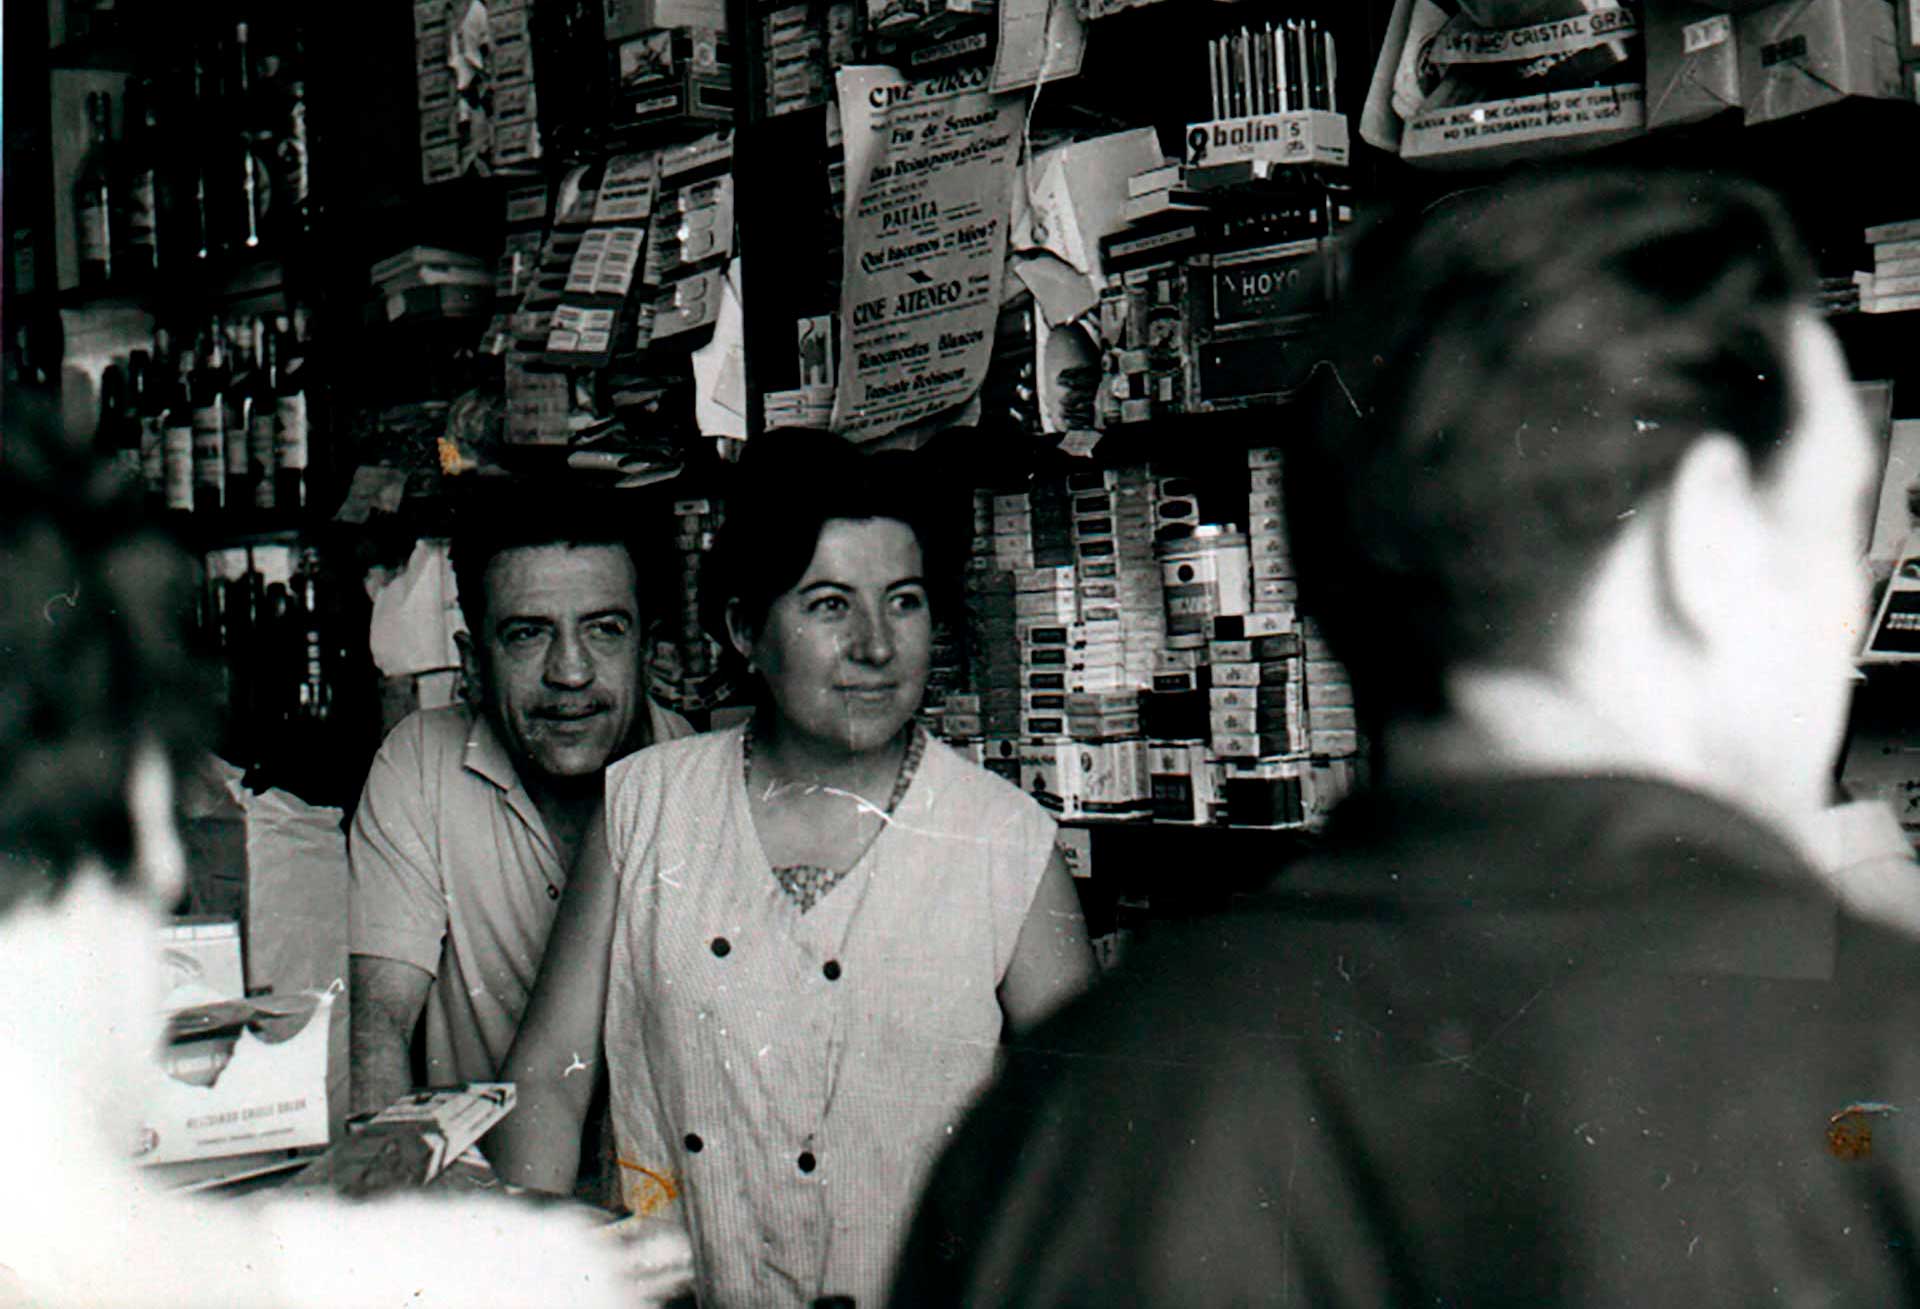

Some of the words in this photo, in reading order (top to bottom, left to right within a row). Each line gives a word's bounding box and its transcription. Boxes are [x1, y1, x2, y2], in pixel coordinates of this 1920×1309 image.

[1511, 18, 1584, 48] CRISTAL
[868, 81, 914, 108] CINE
[925, 65, 989, 96] CIRCO
[891, 127, 915, 145] Fin
[921, 121, 939, 139] de
[943, 109, 999, 132] Semana
[881, 200, 939, 230] PATATA
[852, 298, 887, 326] CINE
[894, 279, 962, 316] ATENEO
